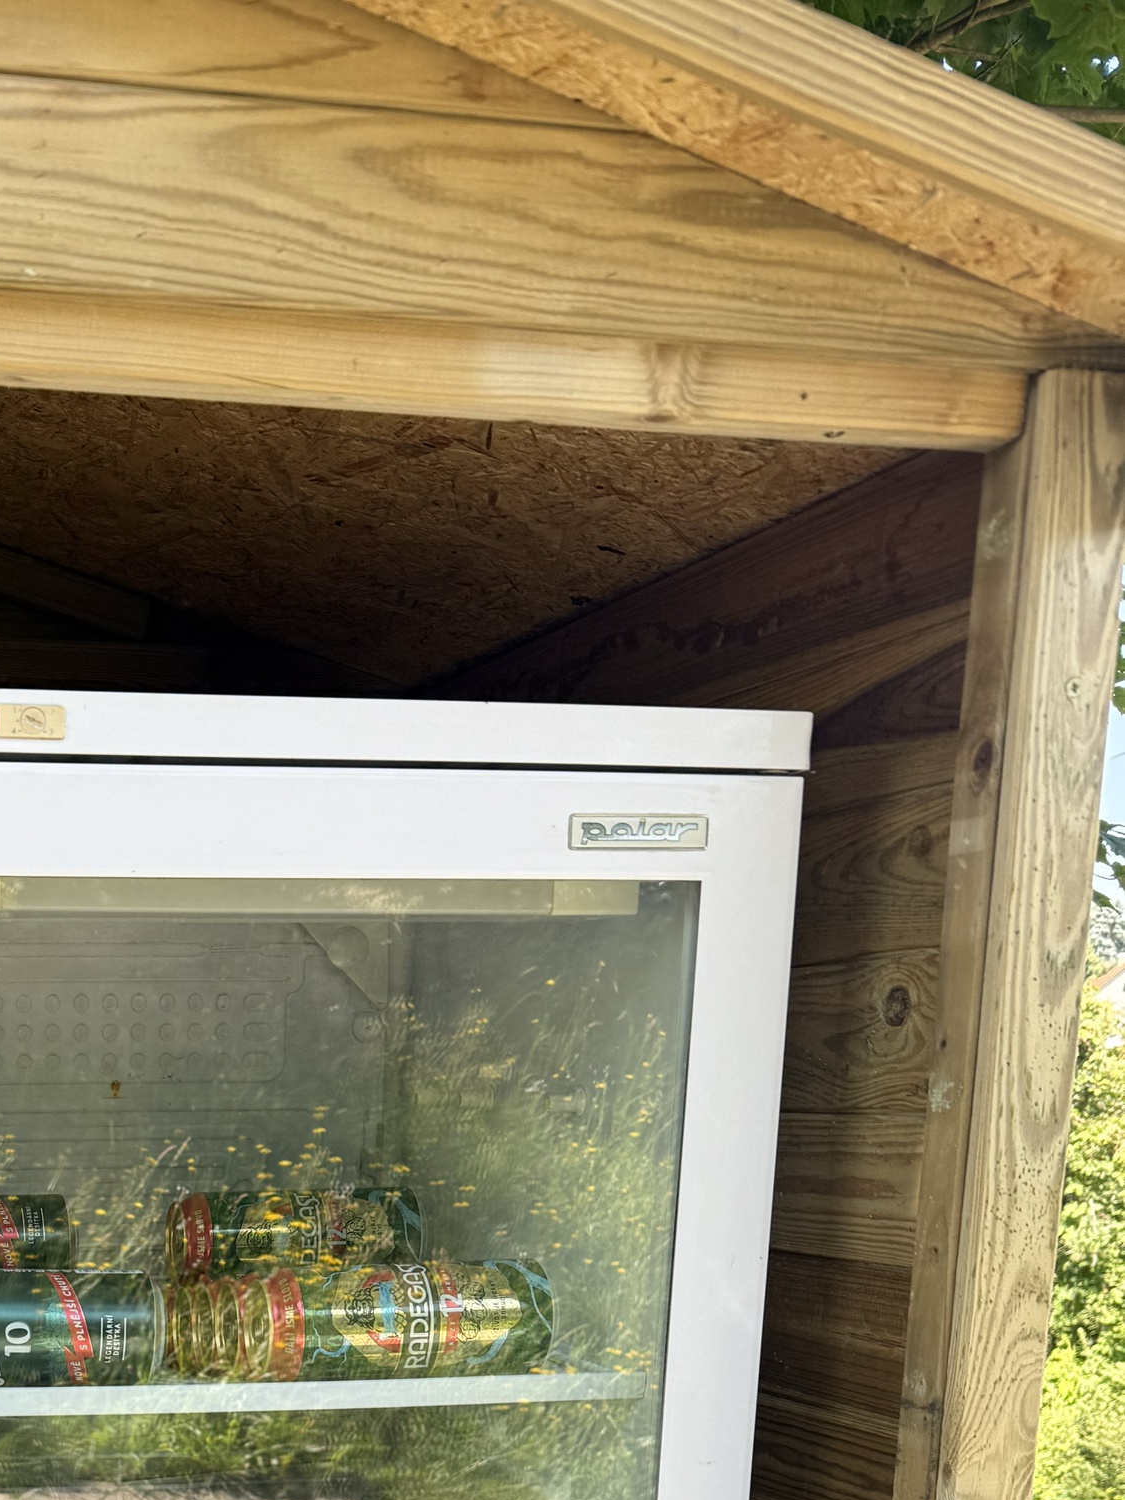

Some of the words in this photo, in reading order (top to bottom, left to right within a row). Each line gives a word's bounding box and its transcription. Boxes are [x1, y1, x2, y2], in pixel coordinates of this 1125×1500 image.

[327, 1227, 347, 1250] 12
[278, 1277, 293, 1303] SLOVO
[63, 1298, 87, 1342] PLNĚJŠÍ
[284, 1303, 295, 1329] JSME
[439, 1293, 465, 1318] 12
[4, 1321, 32, 1358] 10
[104, 1314, 114, 1364] LEGENDÁRNÍ
[112, 1323, 122, 1356] DESÍTKA
